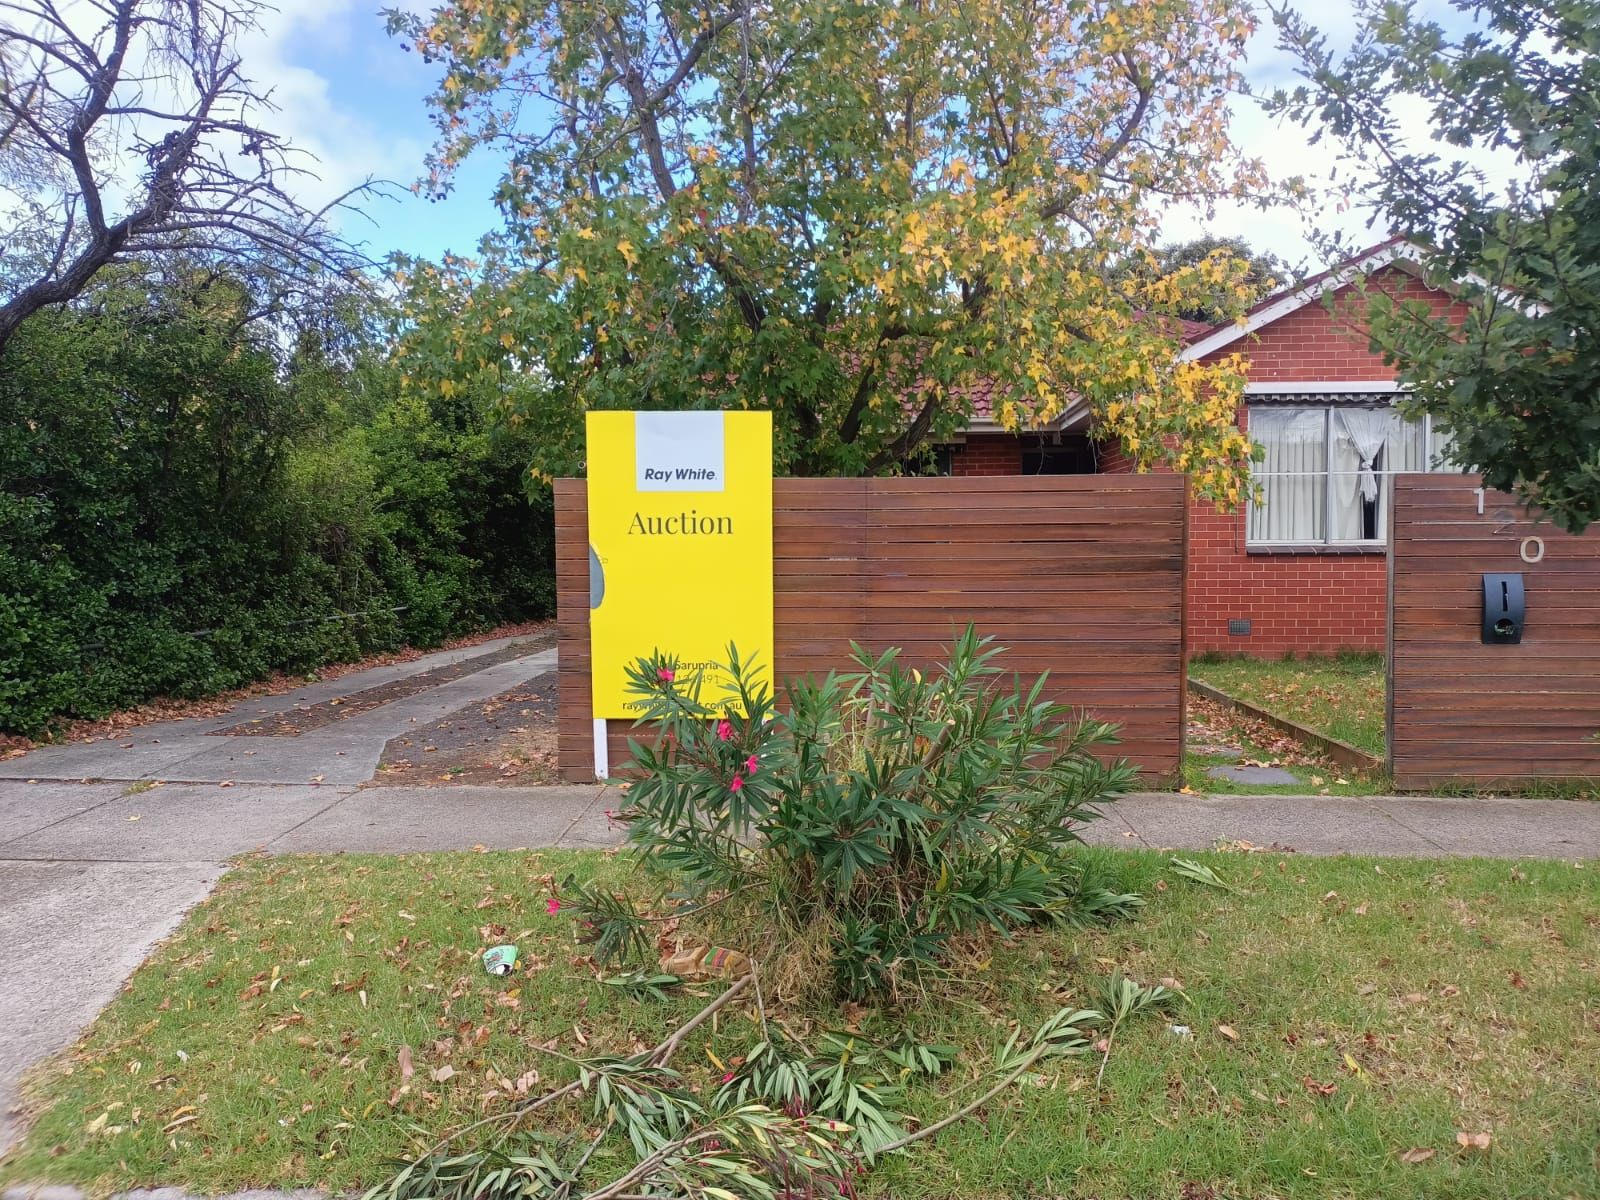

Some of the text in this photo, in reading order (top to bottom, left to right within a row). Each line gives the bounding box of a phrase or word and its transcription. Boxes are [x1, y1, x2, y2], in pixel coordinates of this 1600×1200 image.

[644, 467, 716, 482] Ray White
[627, 509, 734, 535] Auction
